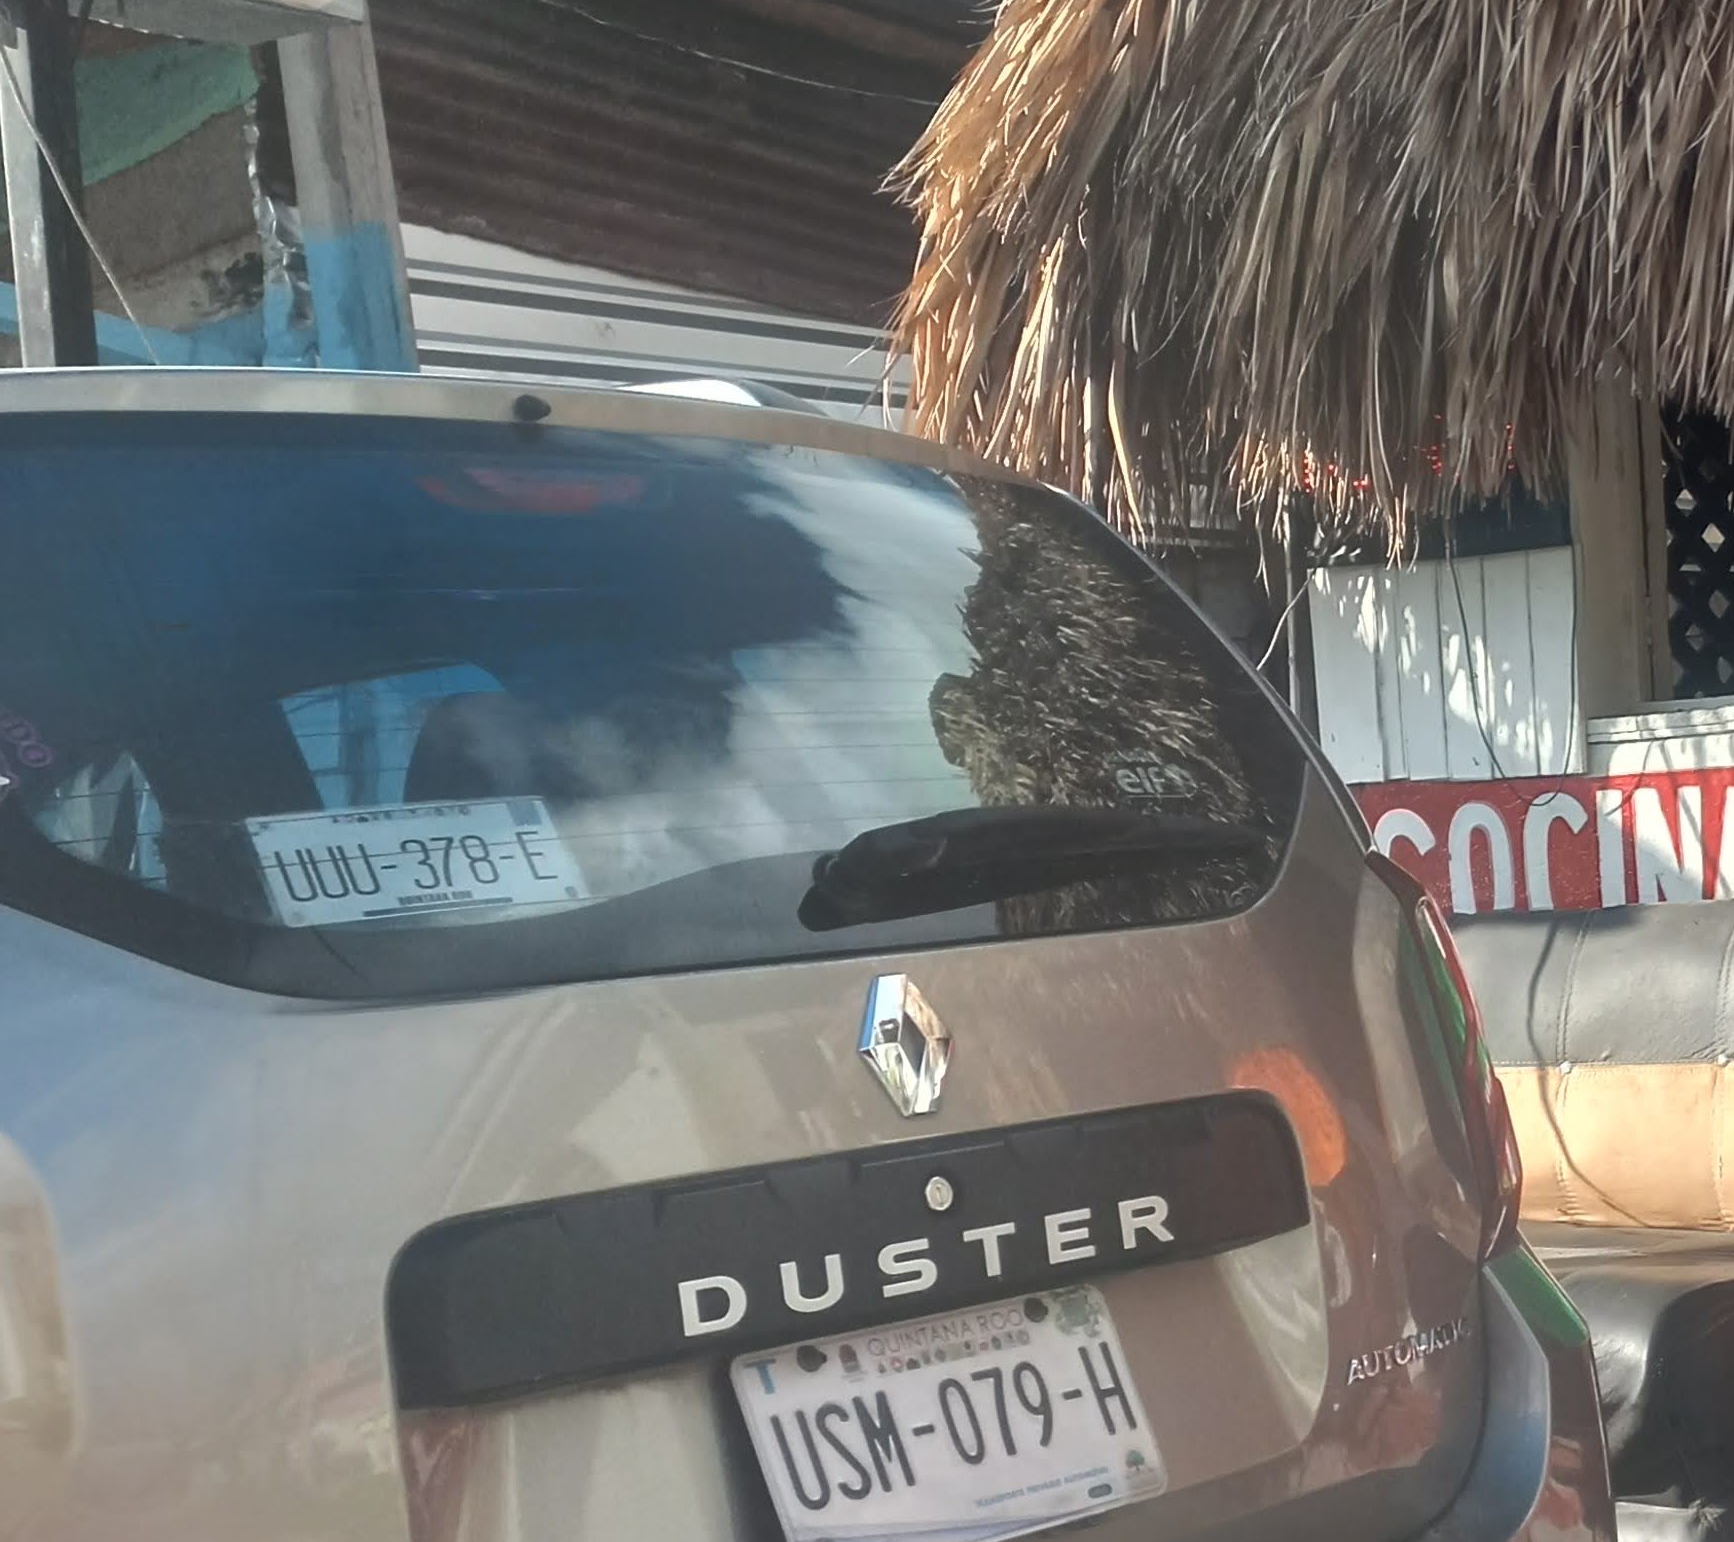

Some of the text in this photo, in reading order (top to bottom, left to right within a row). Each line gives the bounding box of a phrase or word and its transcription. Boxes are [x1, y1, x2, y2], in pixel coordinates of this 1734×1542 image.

[274, 830, 558, 902] UUU-378-E
[678, 1194, 1175, 1339] DUSTER
[769, 1340, 1138, 1511] USM-079-H
